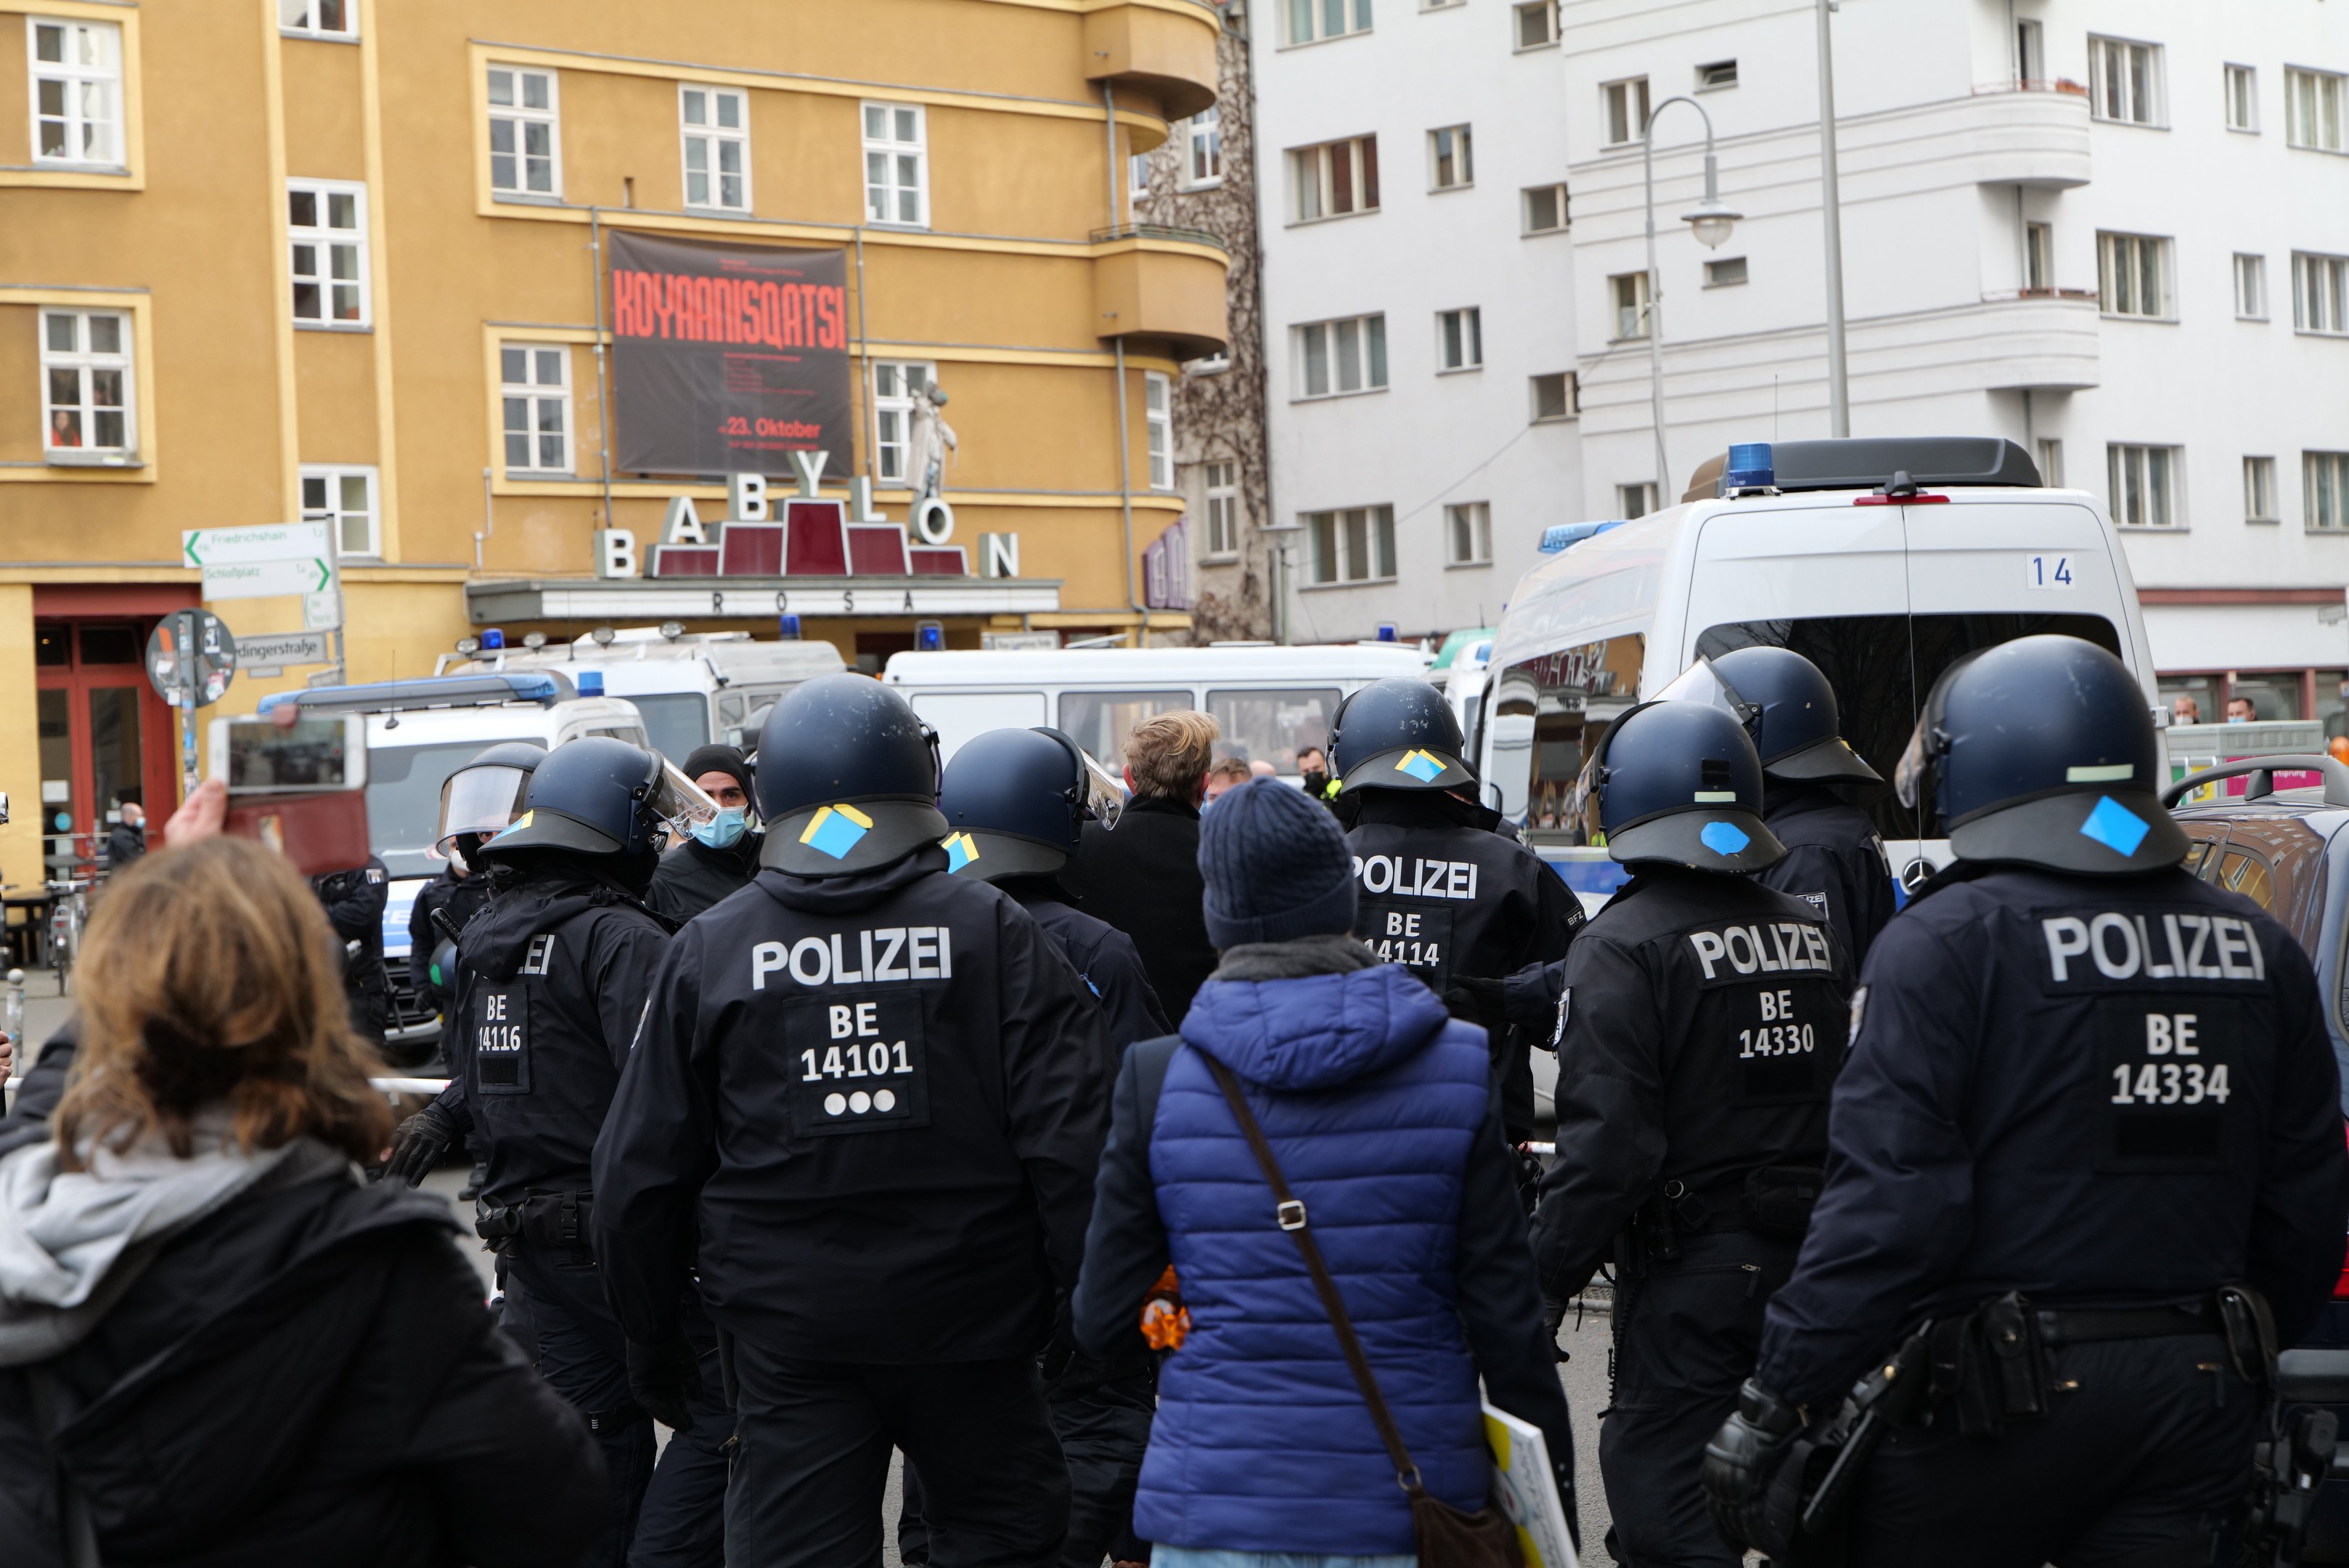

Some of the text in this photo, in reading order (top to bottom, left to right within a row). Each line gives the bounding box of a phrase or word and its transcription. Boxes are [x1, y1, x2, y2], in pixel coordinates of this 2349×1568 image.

[613, 269, 846, 350] KOYAANISQATSI
[727, 416, 752, 436] 23.
[755, 417, 822, 438] Oktober
[604, 451, 1019, 579] BABYLON
[211, 531, 287, 544] Friedrichshain
[204, 566, 261, 579] Schloßplatz
[2033, 557, 2072, 585] 14
[713, 592, 913, 613] ROSA
[235, 639, 317, 661] dingerstraße
[1386, 912, 1421, 936] BE
[1567, 910, 1584, 926] BFZ
[753, 926, 952, 990] POLIZEI
[1689, 923, 1831, 979] POLIZEI
[2042, 912, 2265, 981] POLIZEI
[487, 995, 507, 1021] BE
[829, 1003, 879, 1039] BE
[1760, 989, 1793, 1021] BE
[478, 1025, 520, 1051] 14116
[1739, 1024, 1814, 1058] 14330
[2146, 1013, 2199, 1055] BE
[801, 1040, 913, 1082] 14101
[2111, 1063, 2231, 1105] 14334
